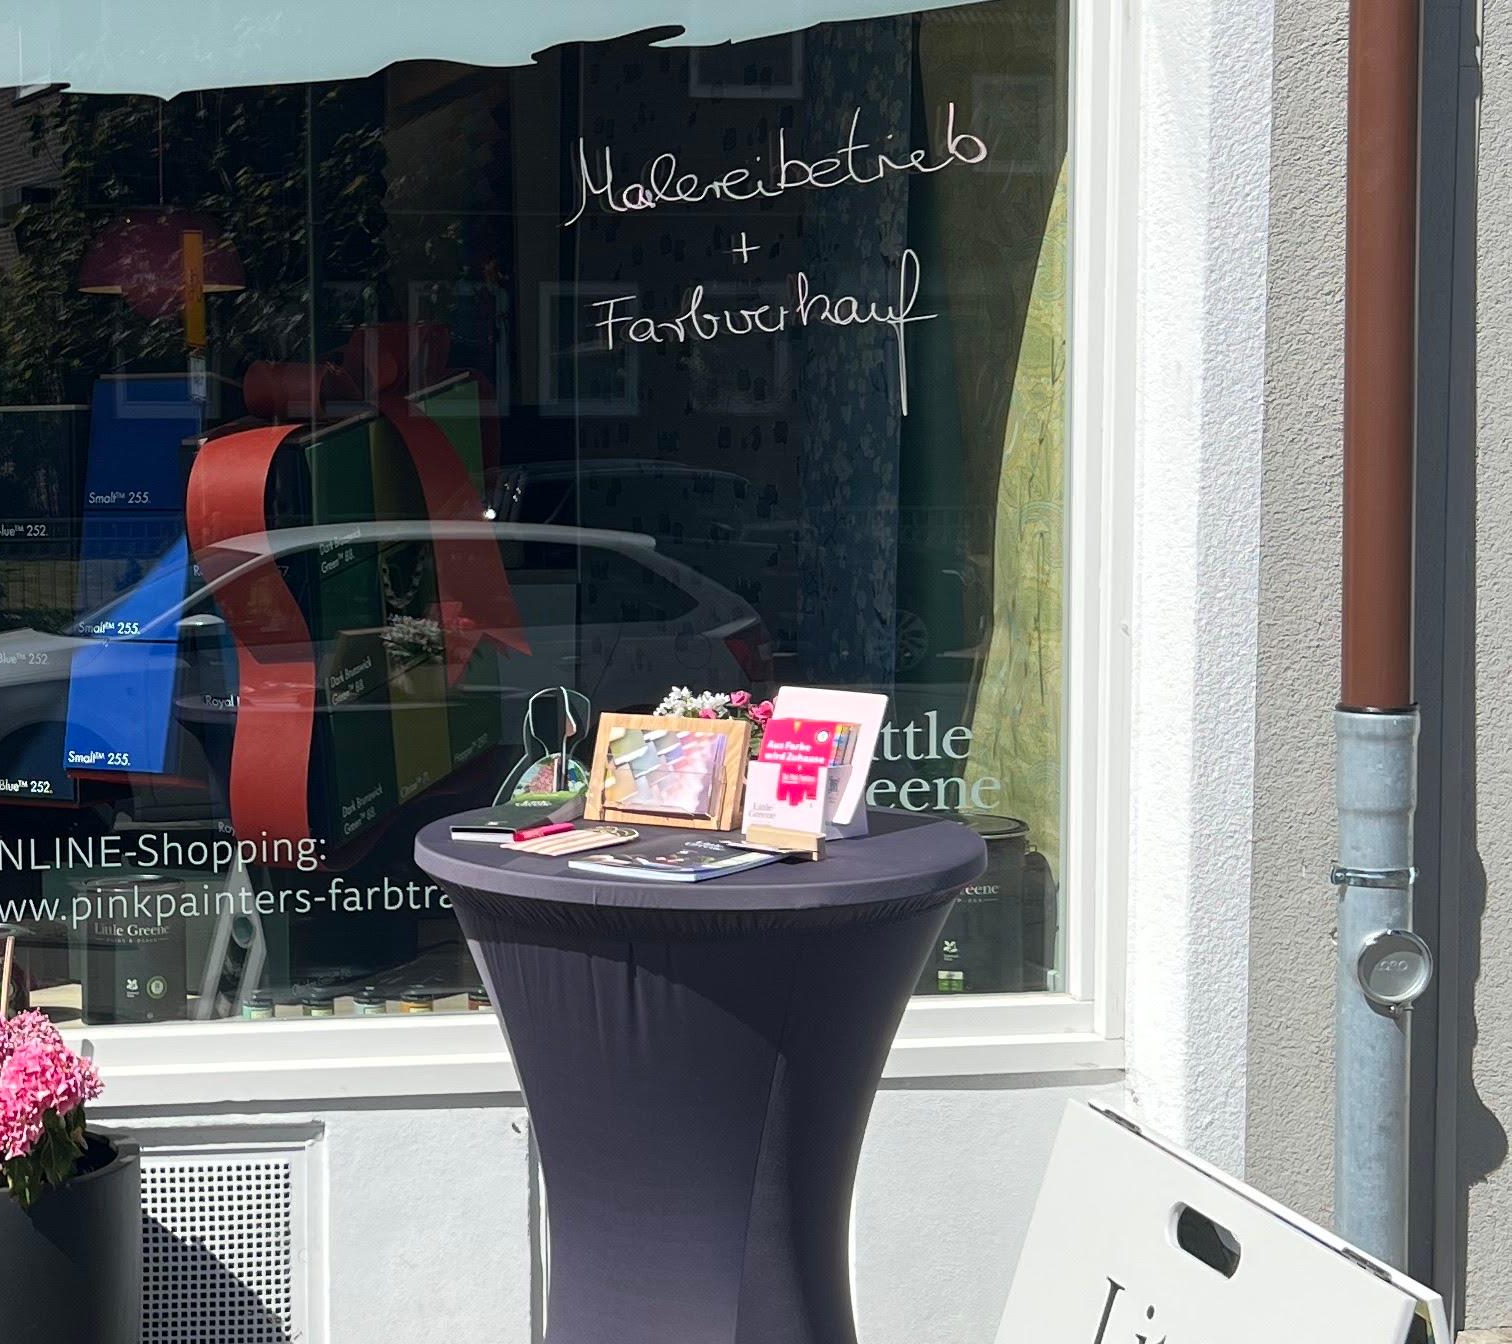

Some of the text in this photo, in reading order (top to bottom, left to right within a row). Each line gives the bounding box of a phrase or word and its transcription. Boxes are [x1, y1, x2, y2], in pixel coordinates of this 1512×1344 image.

[564, 102, 987, 228] Malereibetrieb
[592, 249, 938, 416] Farbverkauf
[205, 694, 234, 710] Royal
[871, 709, 973, 761] ttle
[767, 740, 812, 752] Aus Farbe
[764, 752, 826, 764] wird Zuhause
[866, 776, 1001, 811] eene
[218, 821, 236, 837] Roy
[962, 884, 1000, 895] eene
[94, 922, 124, 936] Little
